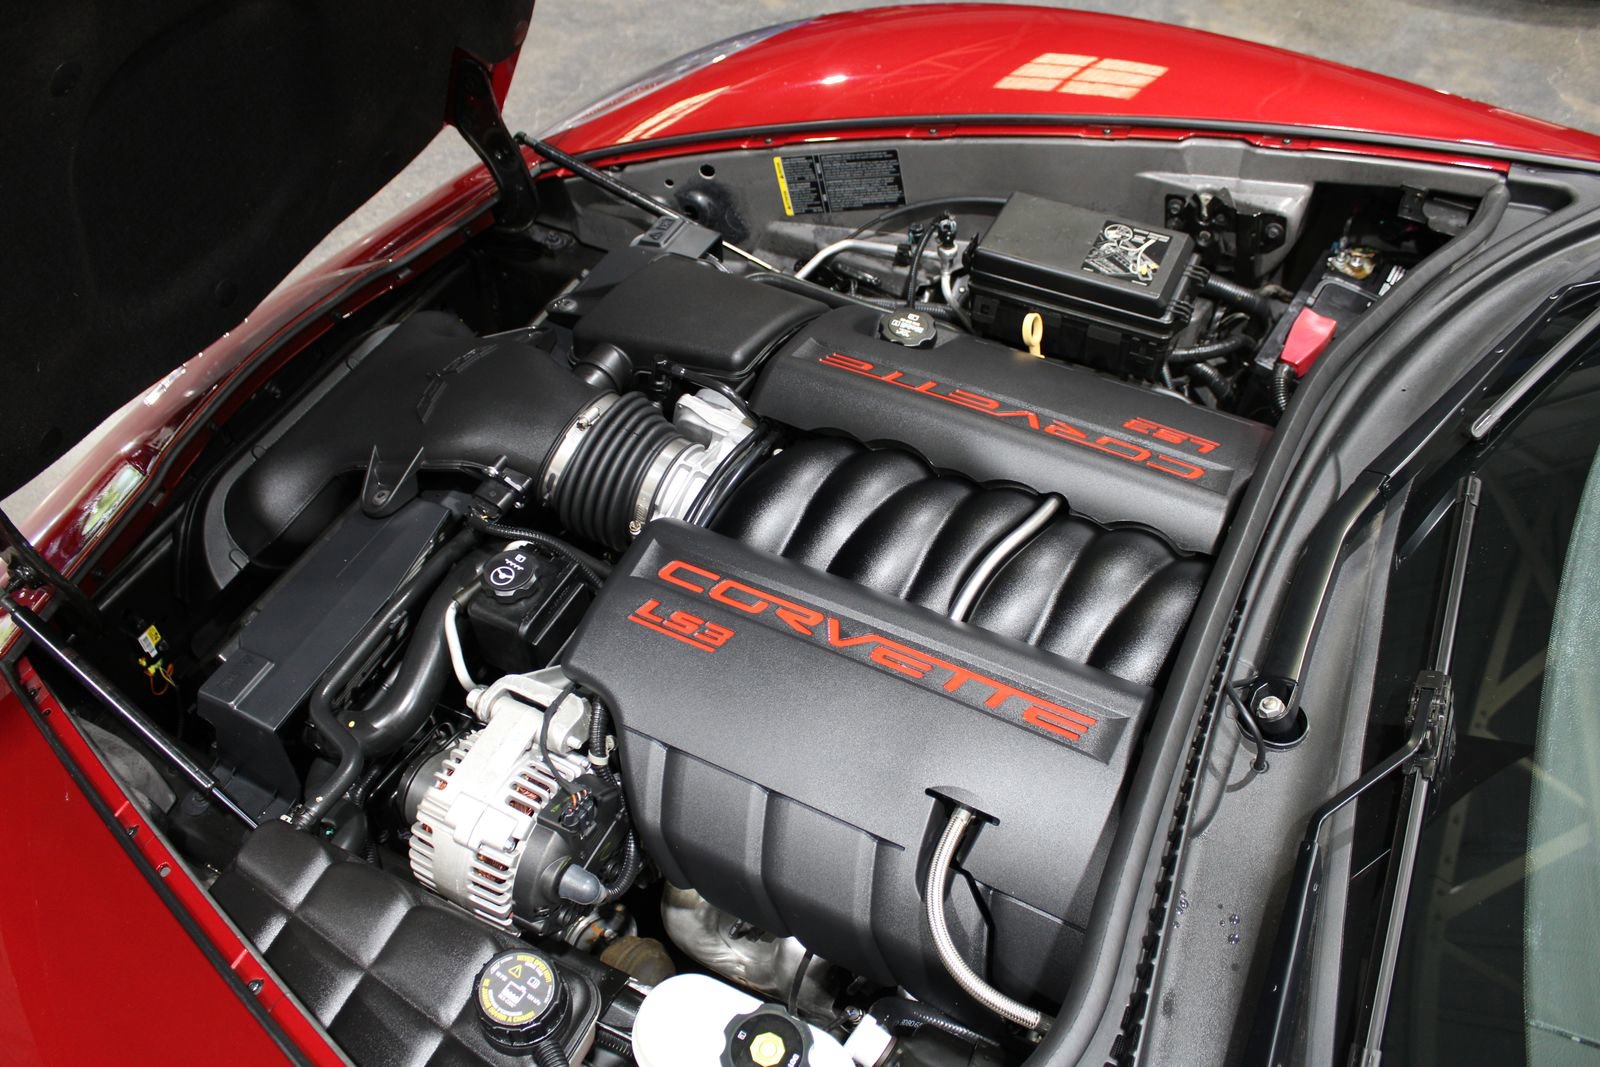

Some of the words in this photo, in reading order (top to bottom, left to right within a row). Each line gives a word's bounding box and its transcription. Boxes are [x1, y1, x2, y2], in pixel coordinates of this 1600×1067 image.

[818, 351, 1206, 480] CORVETTE
[1122, 416, 1221, 454] LS3
[632, 598, 736, 650] LS3
[657, 559, 1098, 741] CORVETTE
